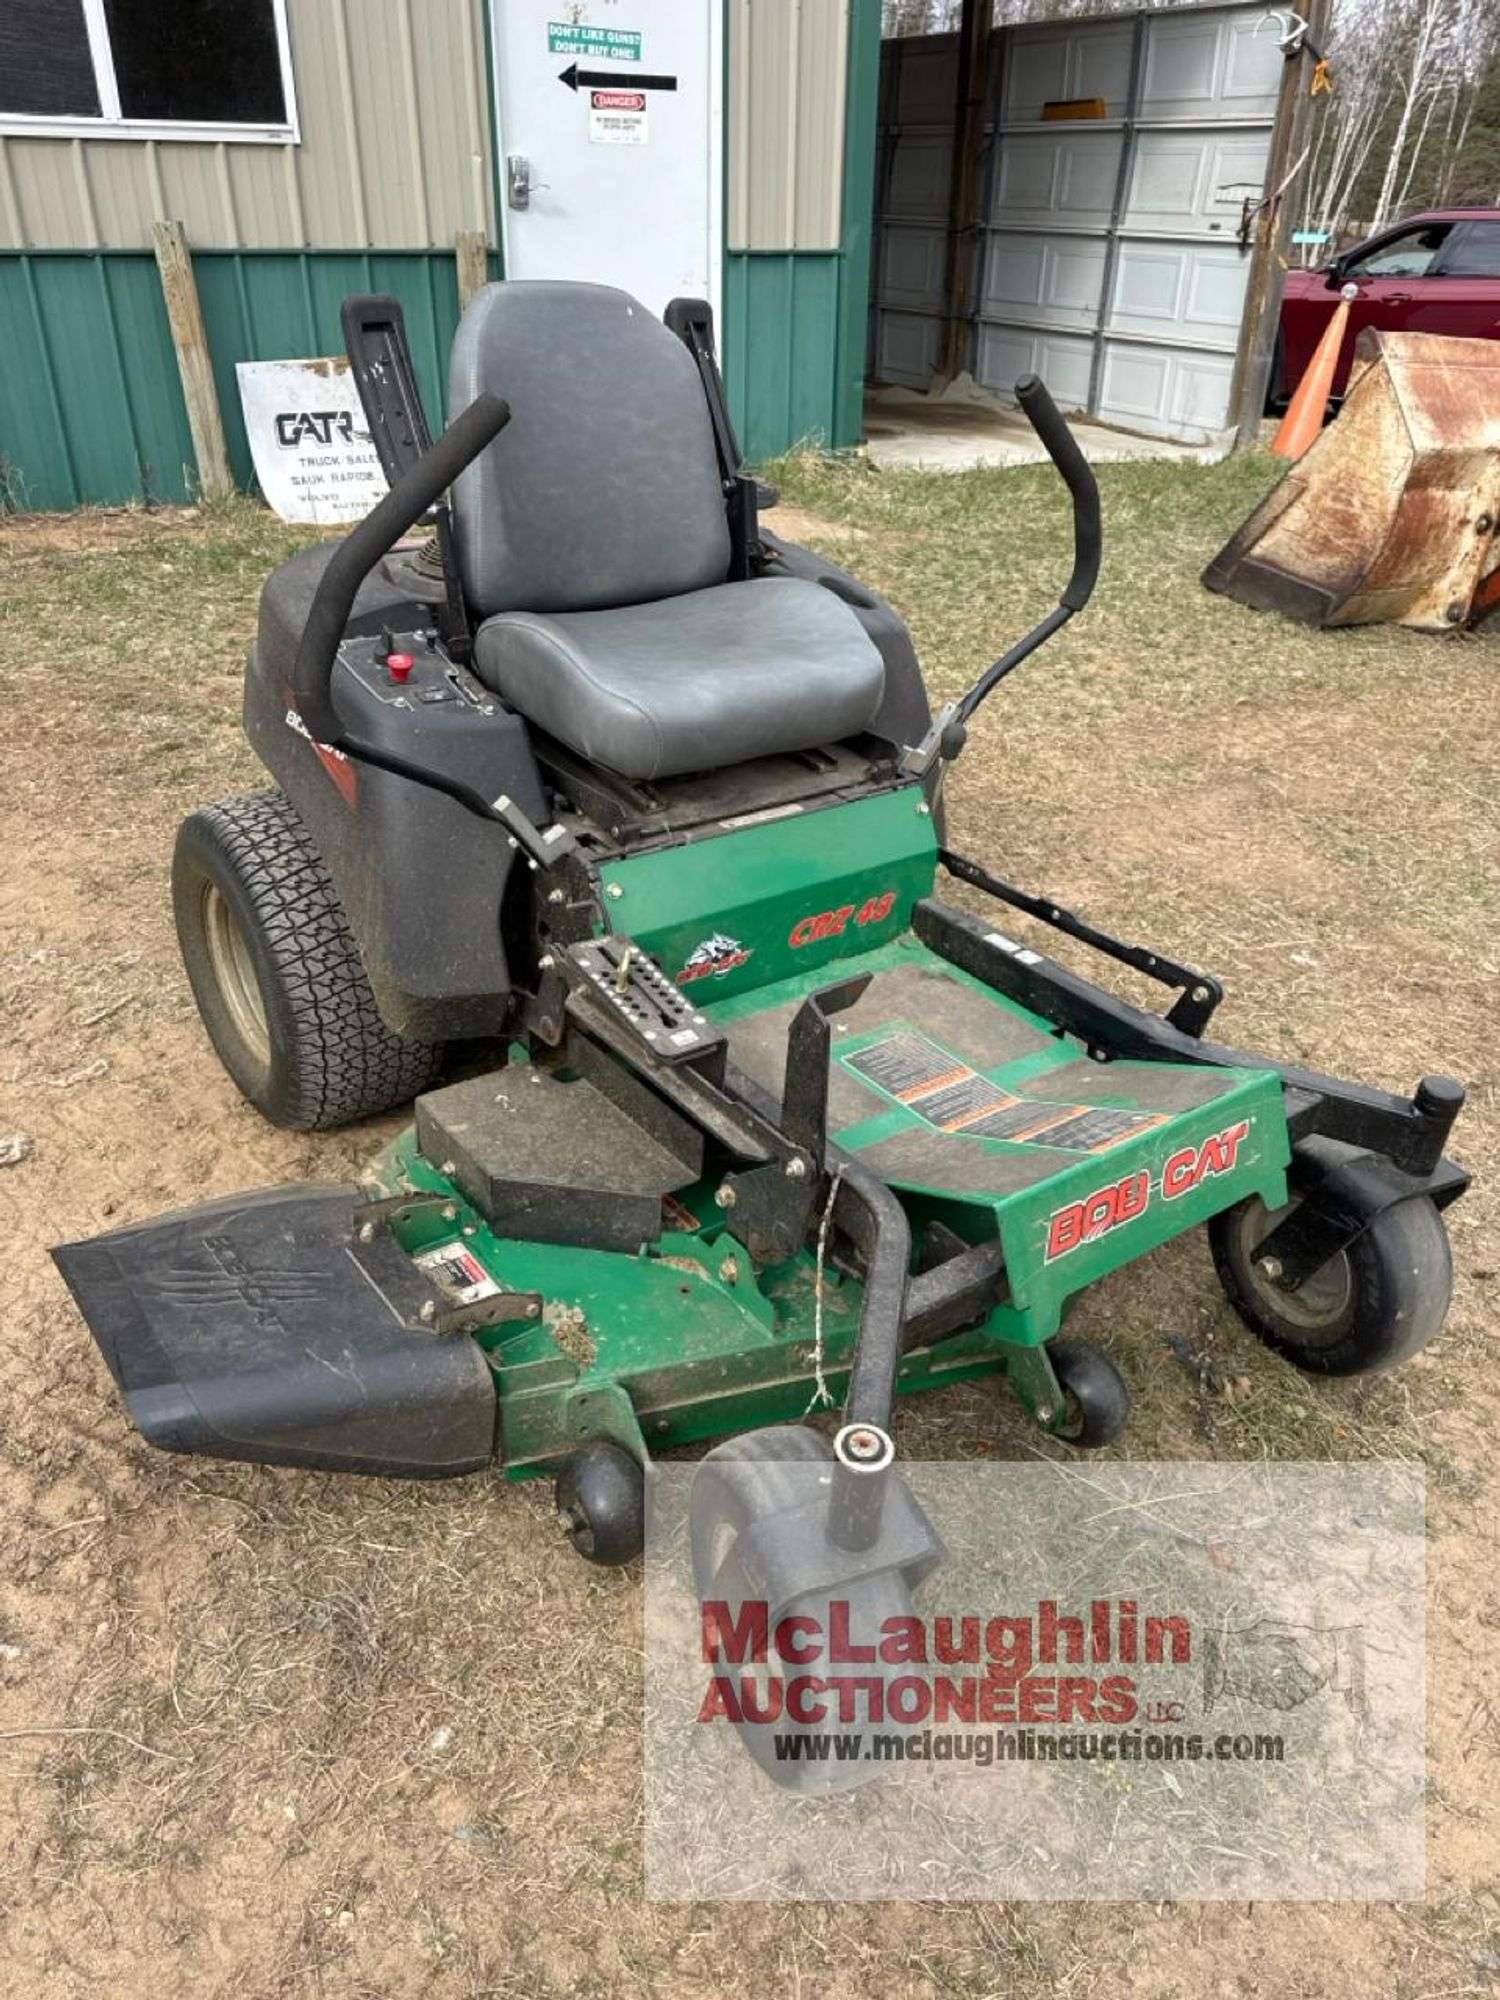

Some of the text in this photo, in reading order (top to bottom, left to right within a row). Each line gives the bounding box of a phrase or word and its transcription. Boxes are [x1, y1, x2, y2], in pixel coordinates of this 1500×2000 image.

[549, 24, 580, 39] DON'T
[581, 28, 605, 42] LIKE
[554, 39, 586, 54] DON'T
[587, 43, 609, 57] BUY
[599, 95, 638, 107] DANGER
[298, 454, 379, 467] TRUCK SALE
